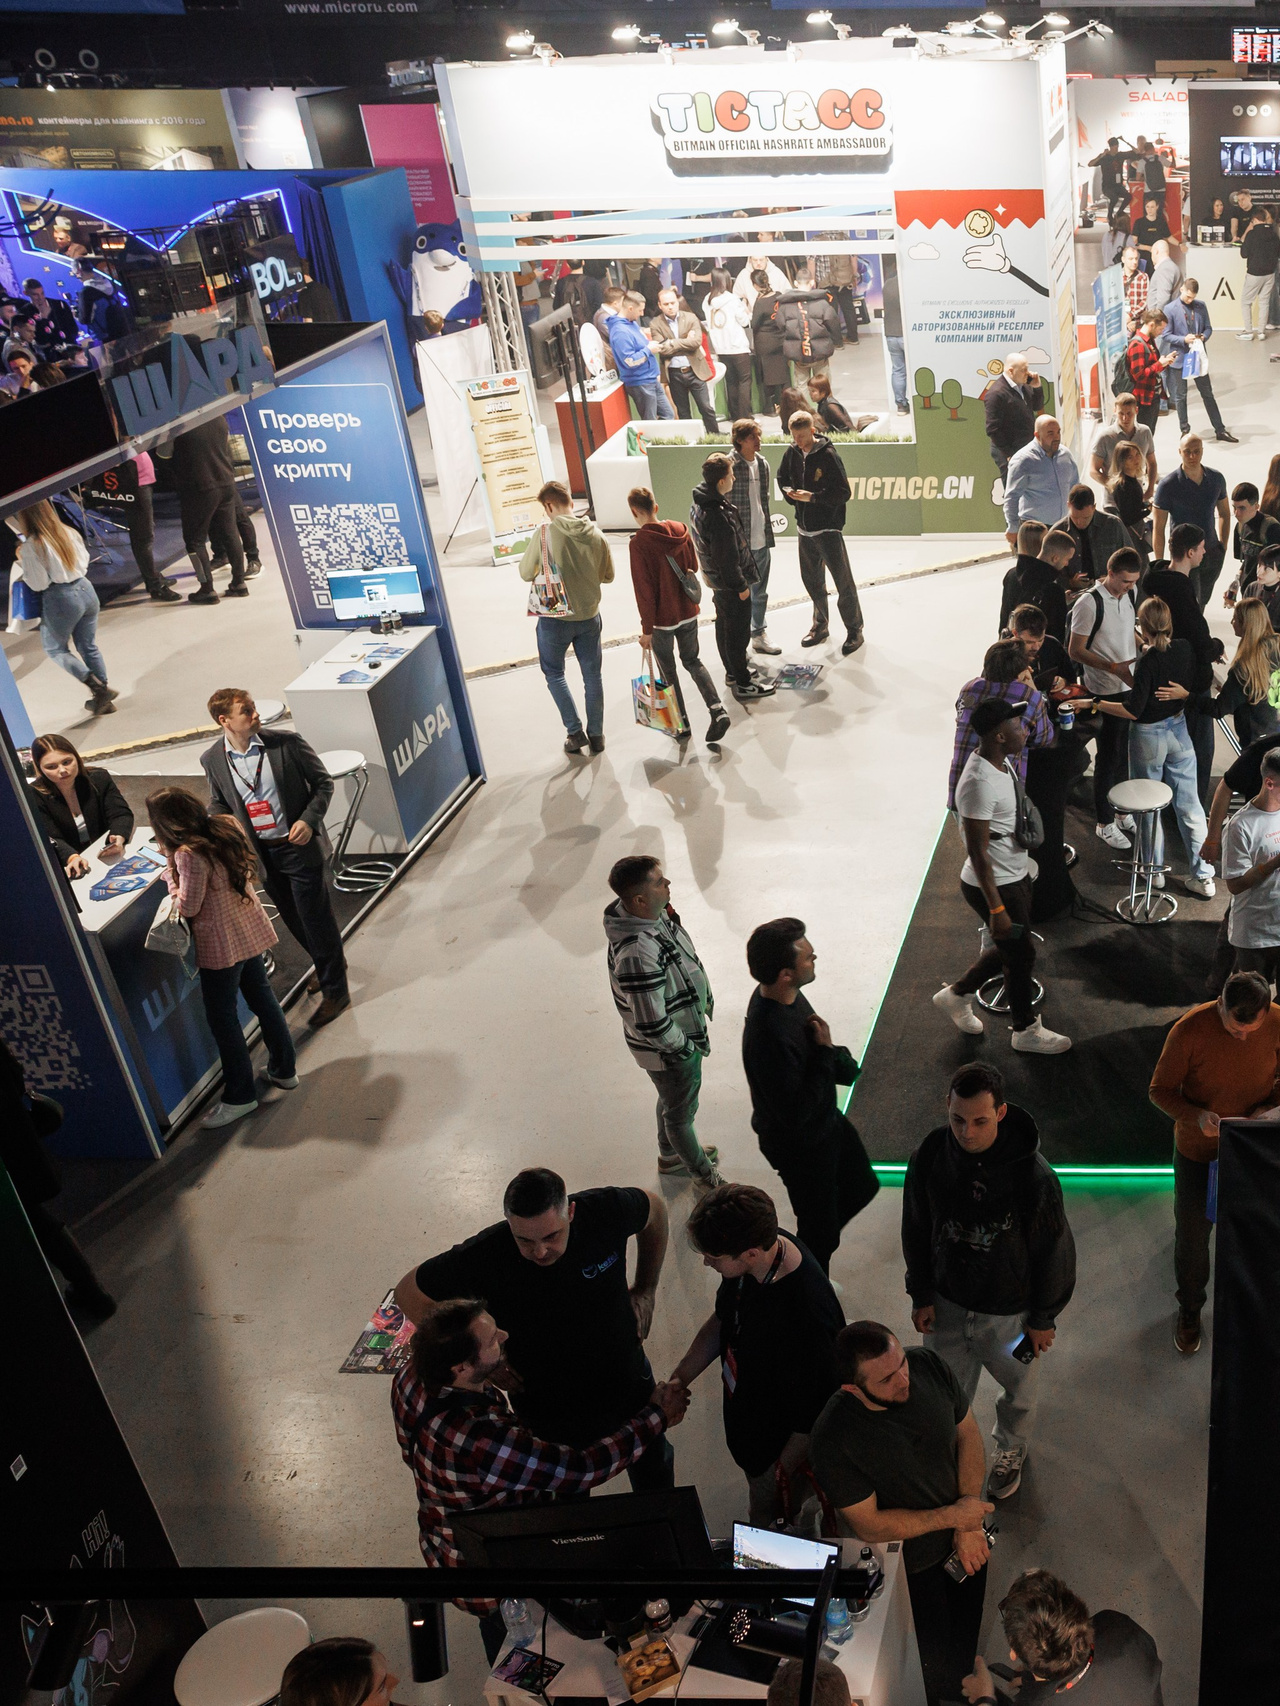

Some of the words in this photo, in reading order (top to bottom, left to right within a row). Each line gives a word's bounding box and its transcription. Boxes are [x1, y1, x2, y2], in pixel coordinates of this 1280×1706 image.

[285, 1, 418, 13] www.microru.com
[657, 87, 885, 134] TICTACC
[38, 116, 92, 126] контейнеры
[93, 117, 110, 126] для
[111, 116, 152, 124] майнинга
[185, 118, 206, 126] года
[673, 140, 716, 151] BITMAIN
[718, 140, 761, 150] OFFICIAL
[763, 139, 814, 150] HASHRATE
[817, 137, 886, 149] AMBASSADOR
[938, 308, 1016, 319] ЭКСКЛЮЗИВНЫЙ
[912, 321, 996, 331] АВТОРИЗОВАННЫЙ
[998, 321, 1045, 331] РЕСЕЛЛЕР
[935, 334, 984, 343] КОМПАНИИ
[986, 333, 1023, 343] BITMAIN
[111, 325, 277, 436] ШАРА
[258, 409, 362, 432] Проверь
[266, 438, 328, 454] свою
[273, 462, 352, 483] крипту
[392, 702, 452, 777] ШАРА
[551, 1534, 606, 1546] ViewSonic
